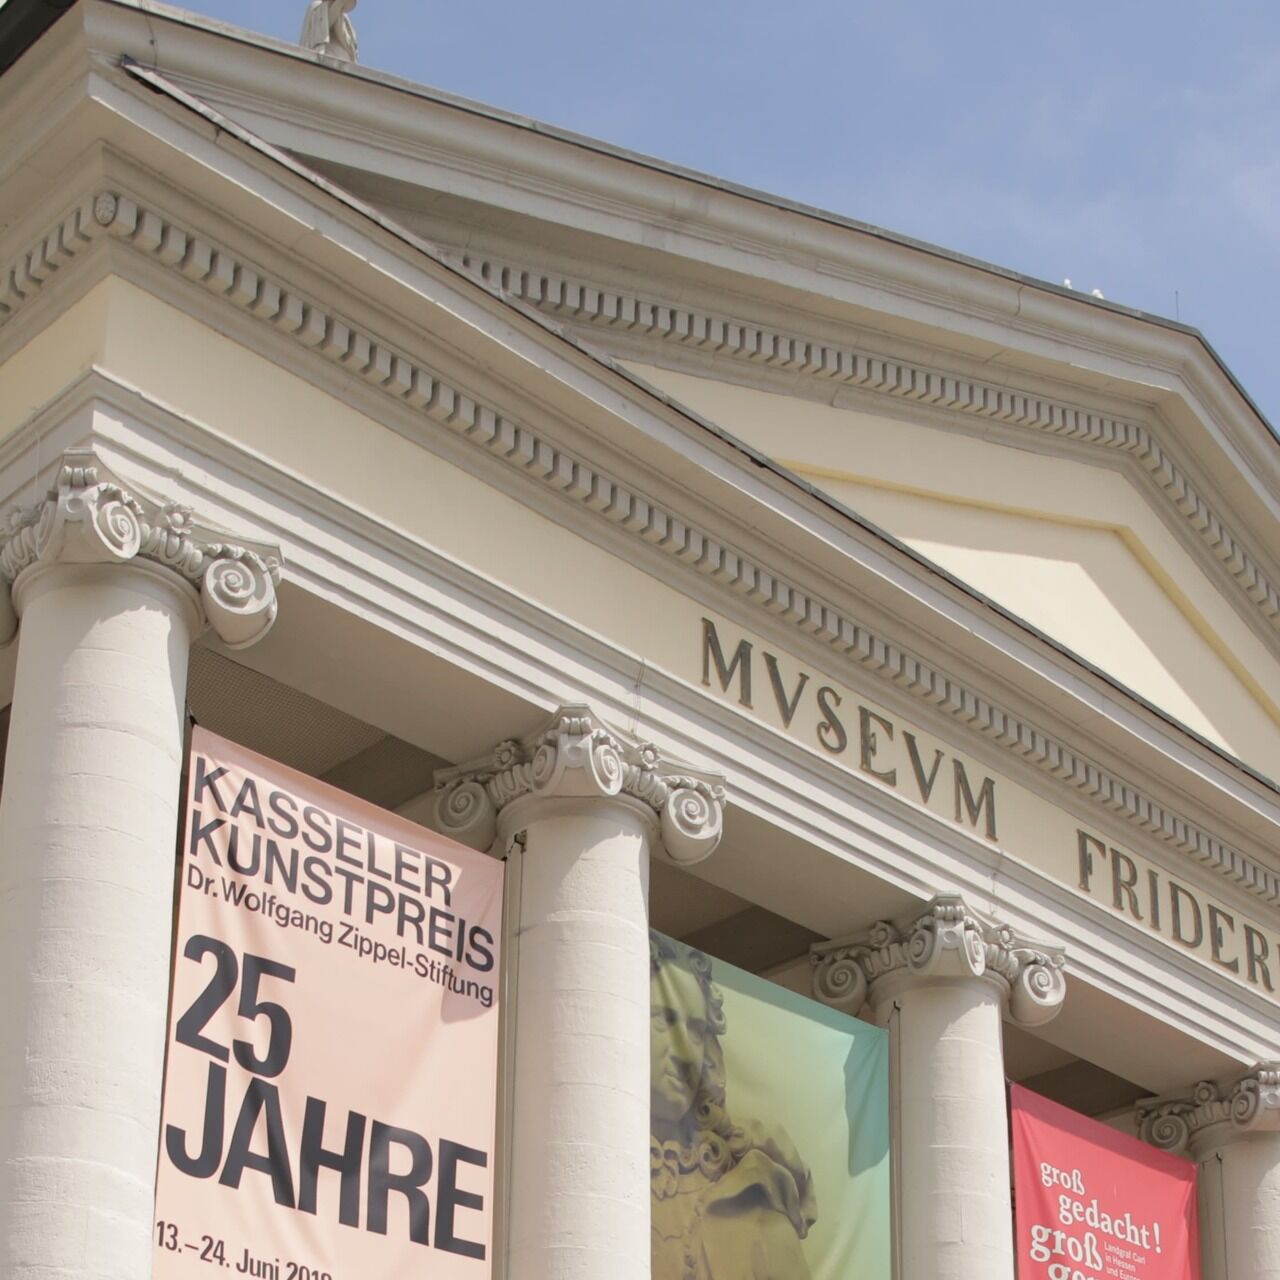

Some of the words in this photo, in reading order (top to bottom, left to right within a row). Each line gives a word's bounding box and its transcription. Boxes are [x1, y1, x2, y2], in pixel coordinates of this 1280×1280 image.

[701, 617, 998, 841] MVSEVM
[190, 809, 494, 972] KUNSTPREIS
[195, 757, 452, 905] KASSELER
[176, 934, 296, 1078] 25
[187, 863, 218, 900] Dr.
[222, 877, 333, 944] Wolfgang
[338, 921, 493, 1007] Zippel-Stiftung
[166, 1061, 488, 1261] JAHRE
[1040, 1162, 1085, 1195] groß
[1058, 1195, 1161, 1253] gedacht!
[1030, 1225, 1103, 1271] groß
